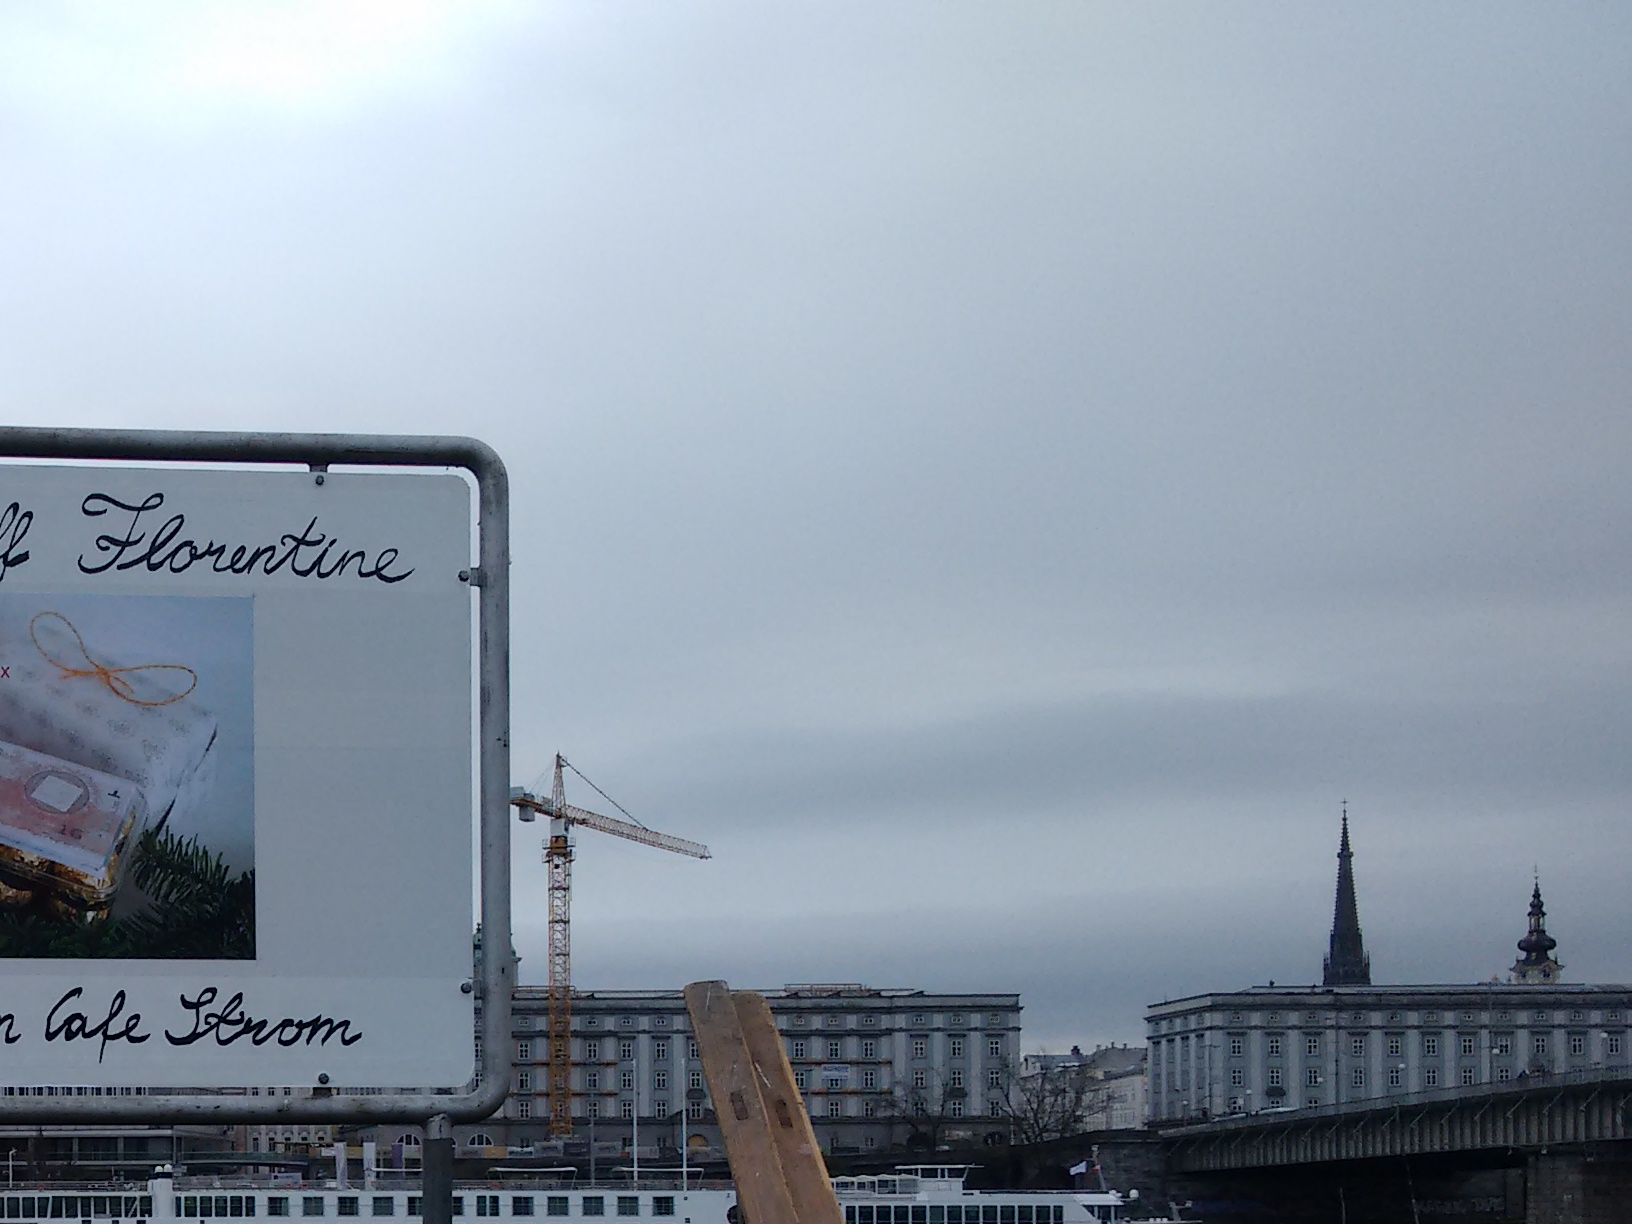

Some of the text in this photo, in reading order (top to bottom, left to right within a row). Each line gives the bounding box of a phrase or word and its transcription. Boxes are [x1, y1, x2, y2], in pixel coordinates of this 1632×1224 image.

[77, 492, 416, 584] Florentine
[43, 986, 152, 1065] Cafe
[163, 986, 364, 1048] Strom
